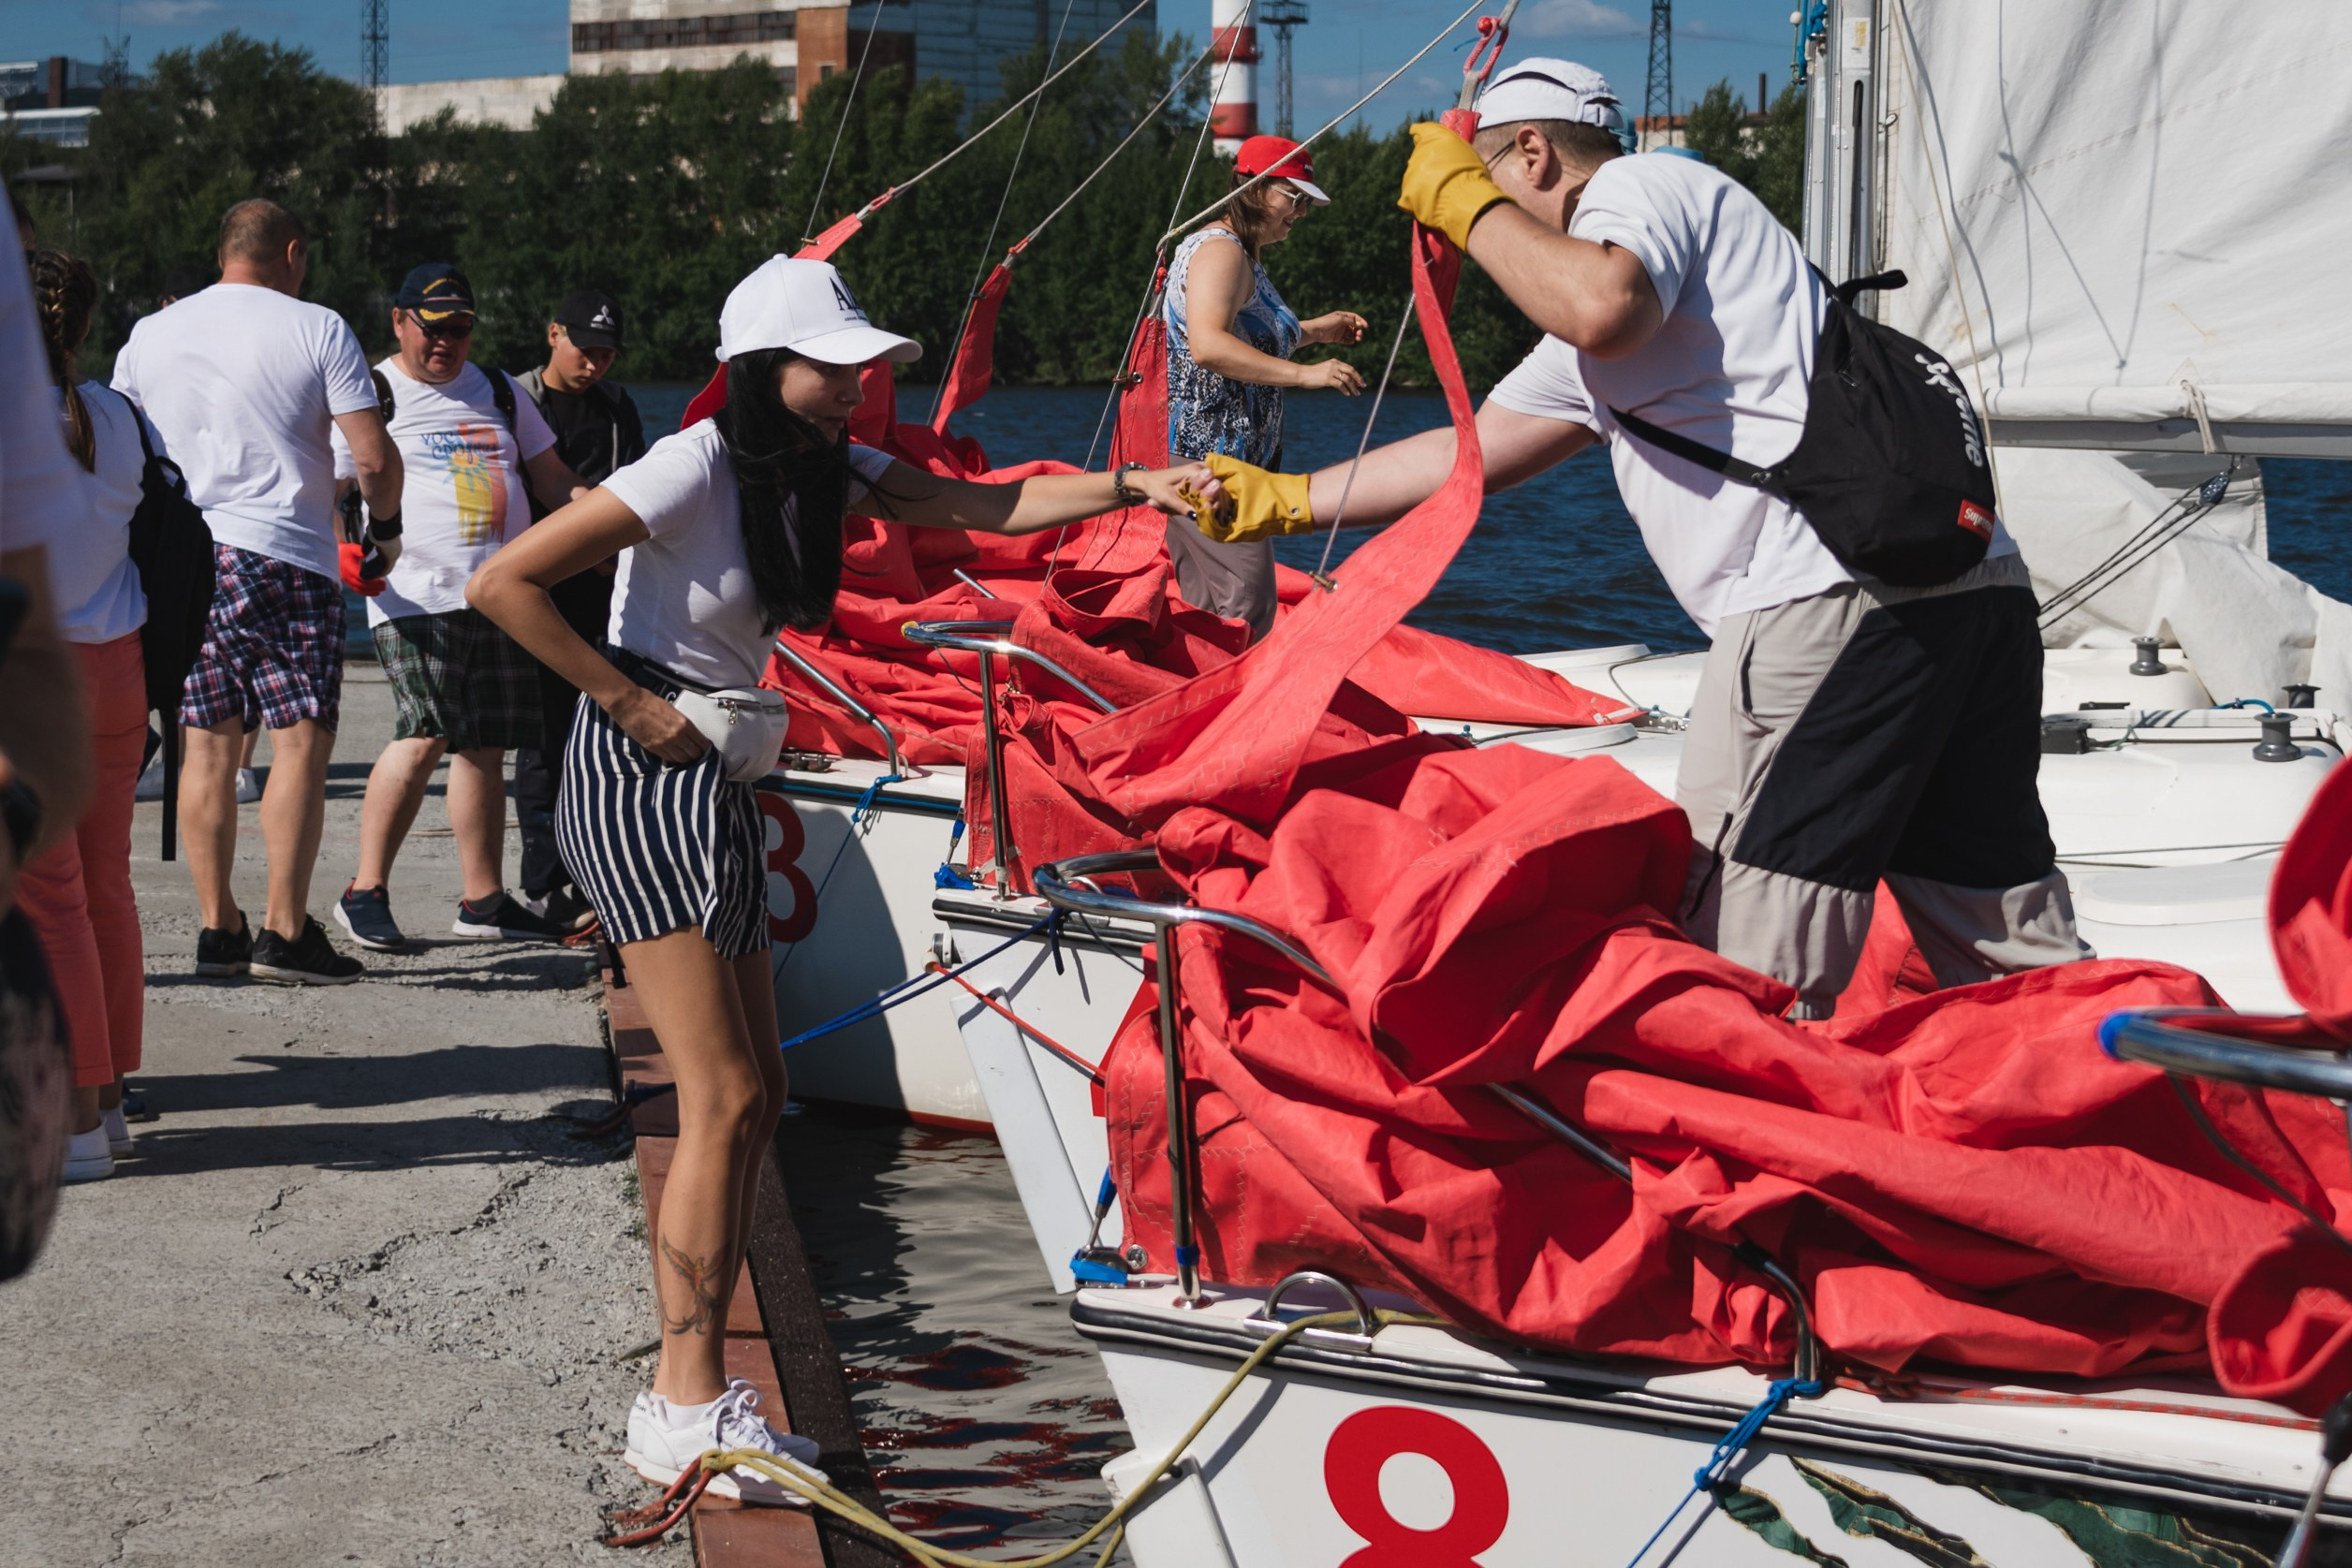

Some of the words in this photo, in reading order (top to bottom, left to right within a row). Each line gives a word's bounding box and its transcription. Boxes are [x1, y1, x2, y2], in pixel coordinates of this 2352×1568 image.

[1963, 506, 1993, 533] Supre
[756, 790, 818, 944] 3
[1324, 1405, 1509, 1568] 8
